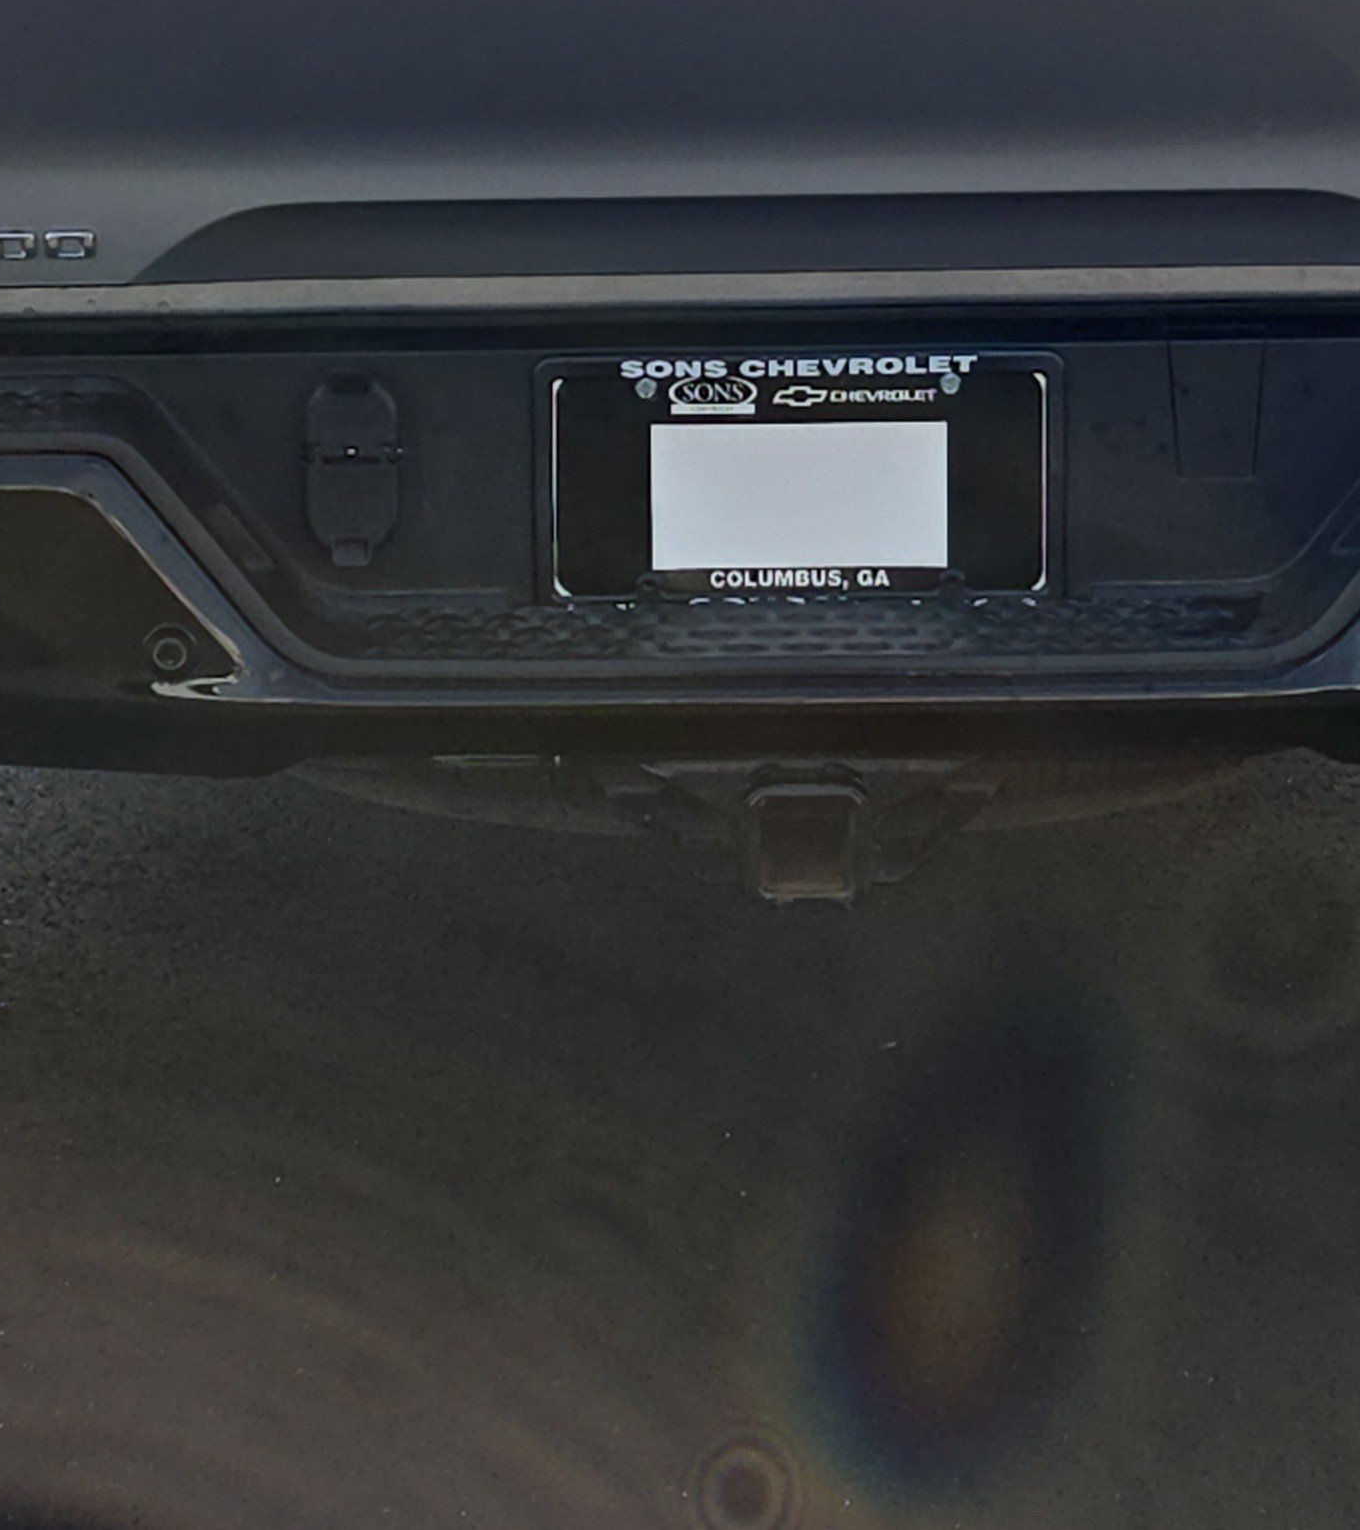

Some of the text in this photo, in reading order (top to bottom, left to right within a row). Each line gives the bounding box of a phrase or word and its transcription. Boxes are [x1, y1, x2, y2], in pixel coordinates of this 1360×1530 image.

[620, 354, 979, 380] SONS CHEVROLET
[682, 382, 745, 403] SONS
[830, 387, 938, 403] CHEVROLET
[709, 569, 891, 590] COLUMBUS, GA
